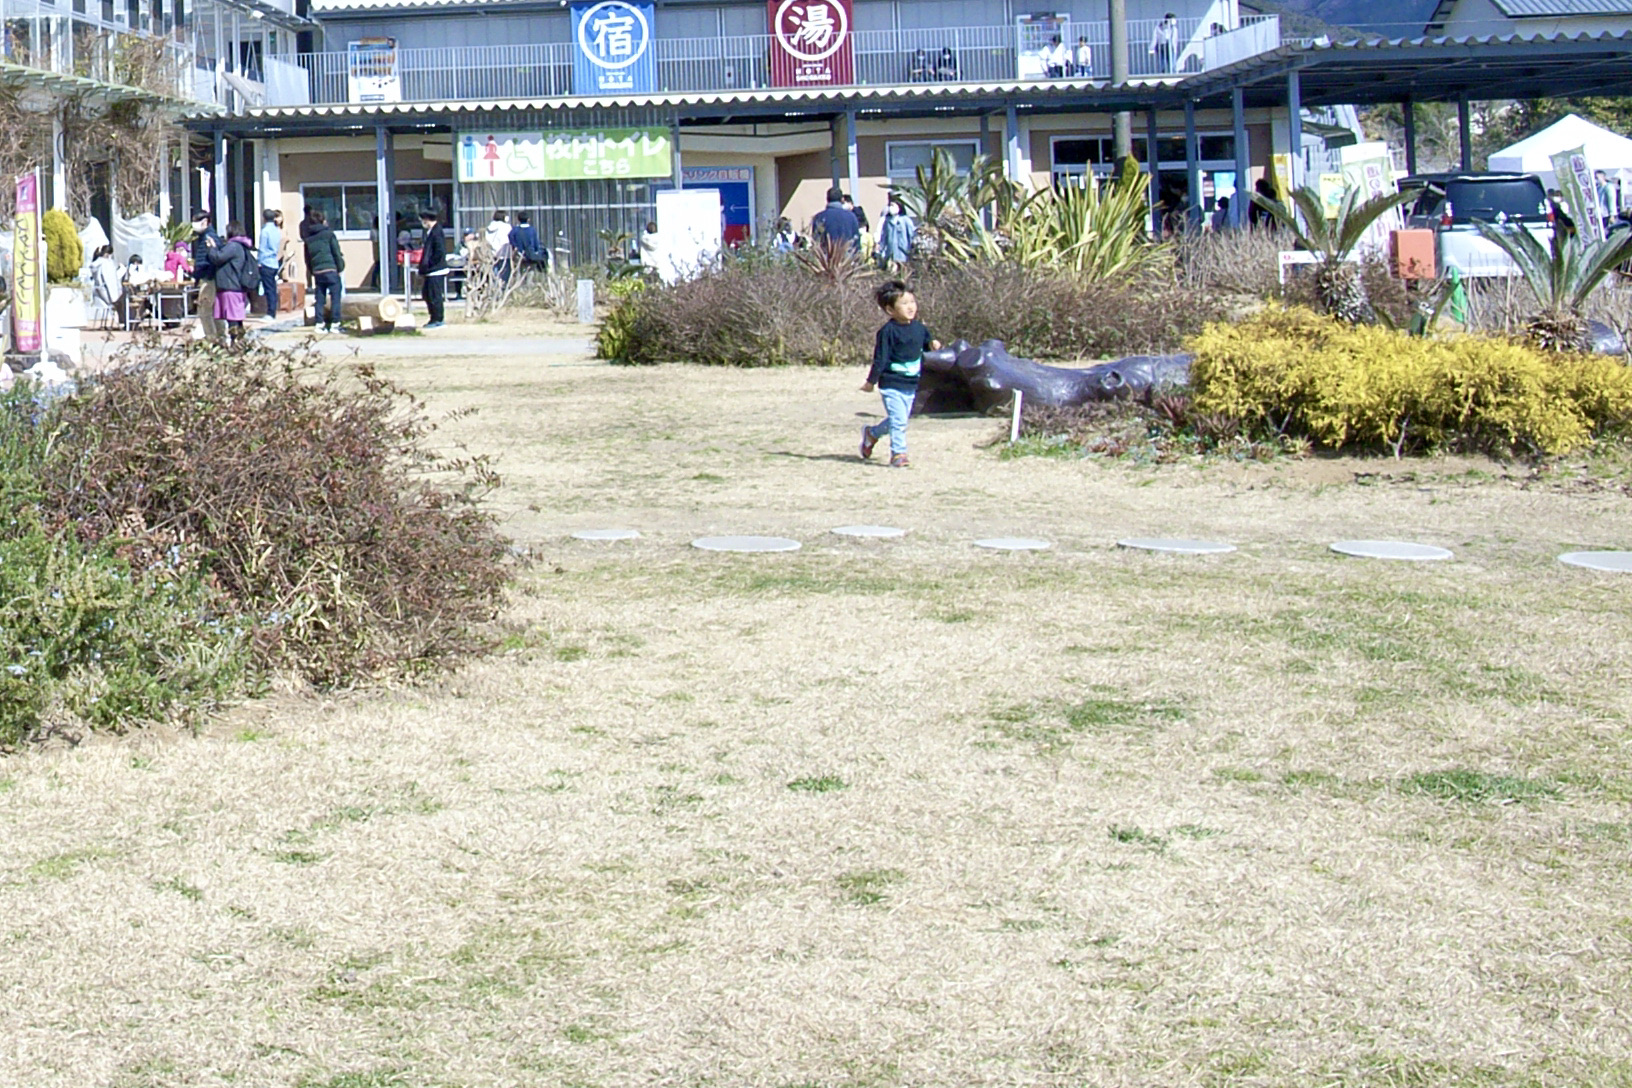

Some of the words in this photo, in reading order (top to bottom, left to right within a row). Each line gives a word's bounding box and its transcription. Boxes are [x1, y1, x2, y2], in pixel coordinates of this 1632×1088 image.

[592, 11, 635, 57] 宿
[788, 3, 835, 49] 湯
[546, 131, 667, 160] 校内トイレ
[583, 158, 631, 176] こちら
